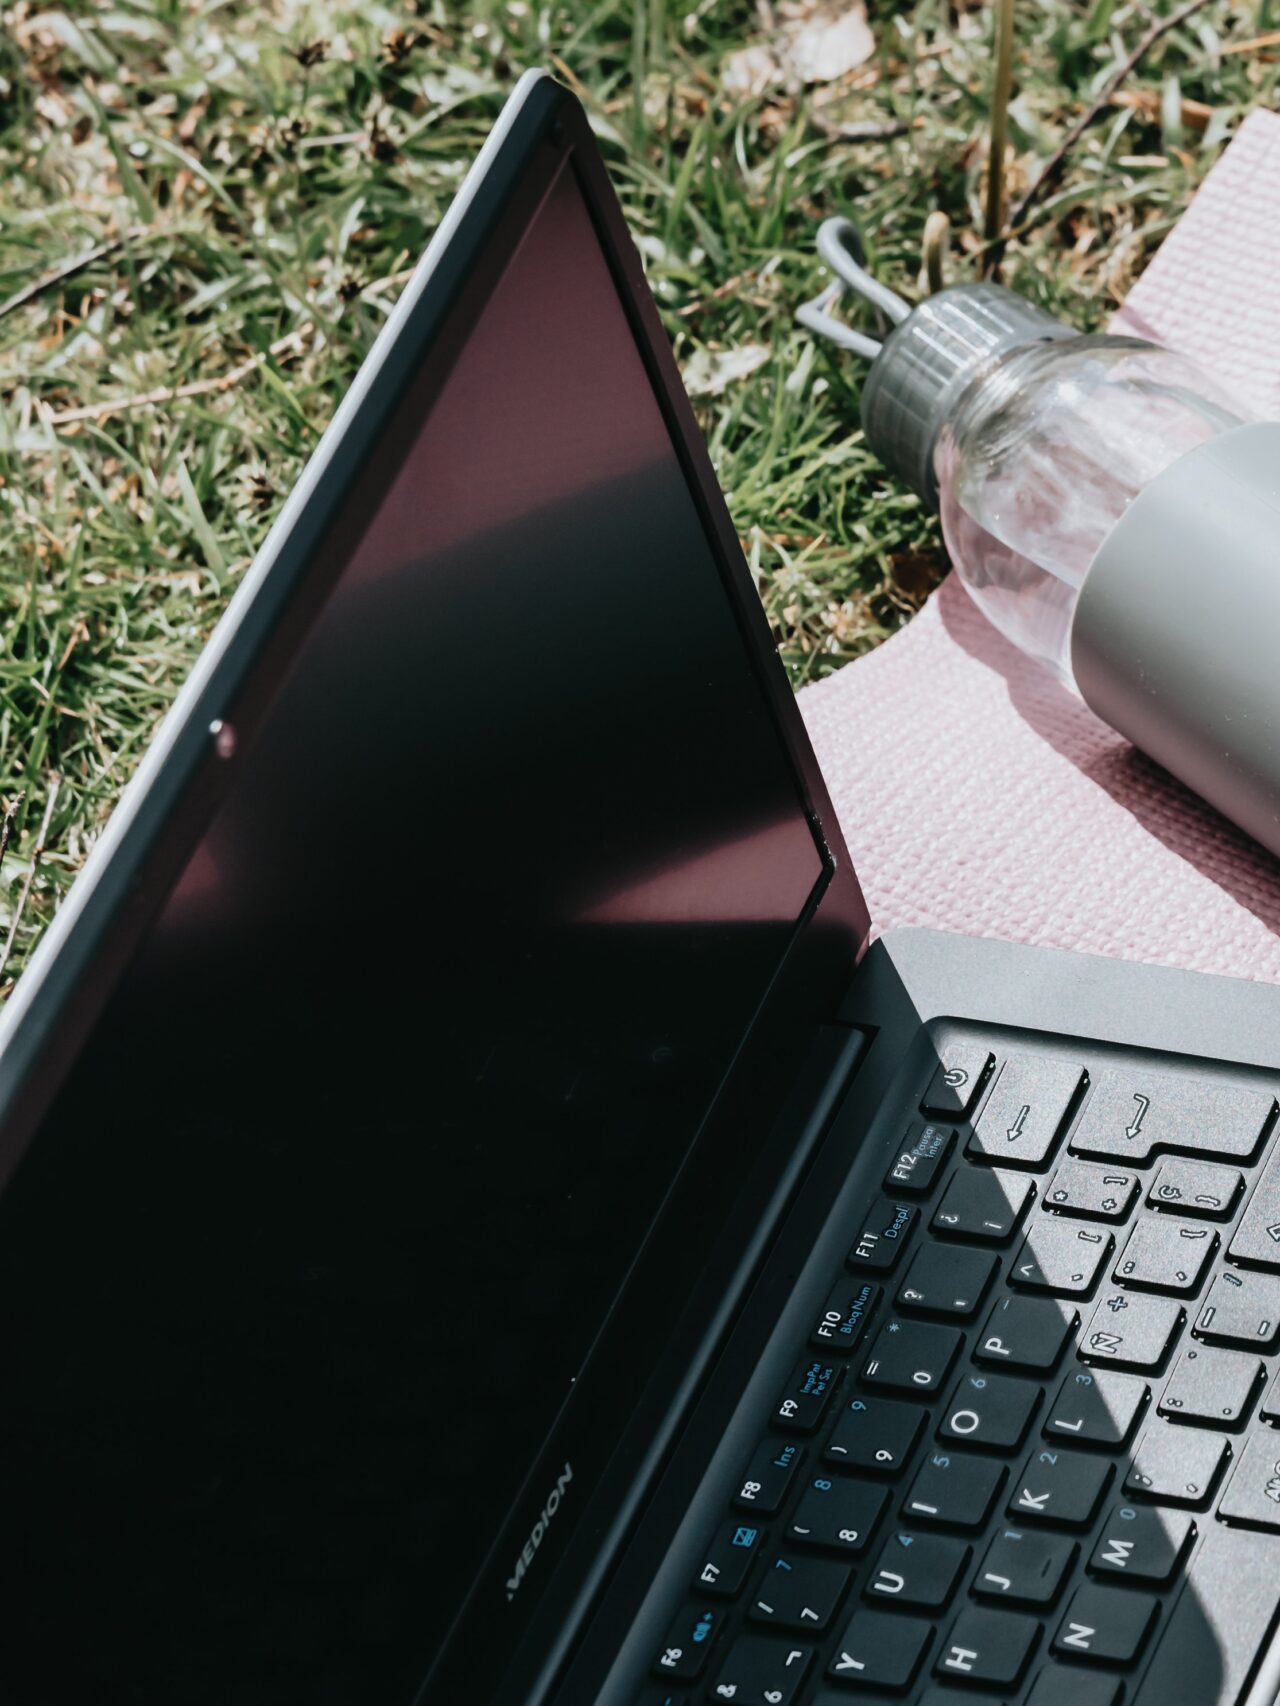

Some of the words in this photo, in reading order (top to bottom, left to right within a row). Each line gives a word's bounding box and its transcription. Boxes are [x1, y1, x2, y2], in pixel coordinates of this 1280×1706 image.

[913, 1128, 934, 1155] Pausa
[925, 1136, 943, 1158] Inter
[893, 1154, 917, 1179] F12
[885, 1207, 909, 1238] Despl
[856, 1234, 878, 1257] F11
[818, 1311, 841, 1337] F10
[985, 1337, 1010, 1355] P
[1091, 1333, 1122, 1354] Ñ
[913, 1372, 932, 1384] 0
[971, 1378, 986, 1389] 6
[1075, 1374, 1092, 1386] 3
[779, 1400, 798, 1417] F9
[852, 1401, 867, 1411] 9
[951, 1410, 979, 1434] O
[1055, 1419, 1083, 1431] L
[774, 1446, 796, 1467] Ins
[875, 1450, 893, 1462] 9
[932, 1456, 950, 1469] 5
[1040, 1453, 1057, 1466] 2
[740, 1481, 762, 1500] F8
[814, 1479, 831, 1491] 8
[1019, 1488, 1049, 1510] K
[912, 1502, 938, 1515] I
[1120, 1508, 1136, 1520] 0
[506, 1462, 573, 1602] MEDION
[838, 1529, 858, 1542] 8
[898, 1535, 914, 1547] 4
[1004, 1531, 1022, 1540] 1
[1102, 1539, 1135, 1567] M
[701, 1563, 720, 1583] F7
[776, 1560, 792, 1571] 7
[874, 1571, 905, 1593] U
[985, 1573, 1011, 1590] J
[800, 1607, 819, 1621] 7
[1063, 1622, 1095, 1648] N
[661, 1648, 682, 1667] F6
[836, 1652, 865, 1670] Y
[945, 1646, 977, 1671] H
[764, 1690, 783, 1704] 6
